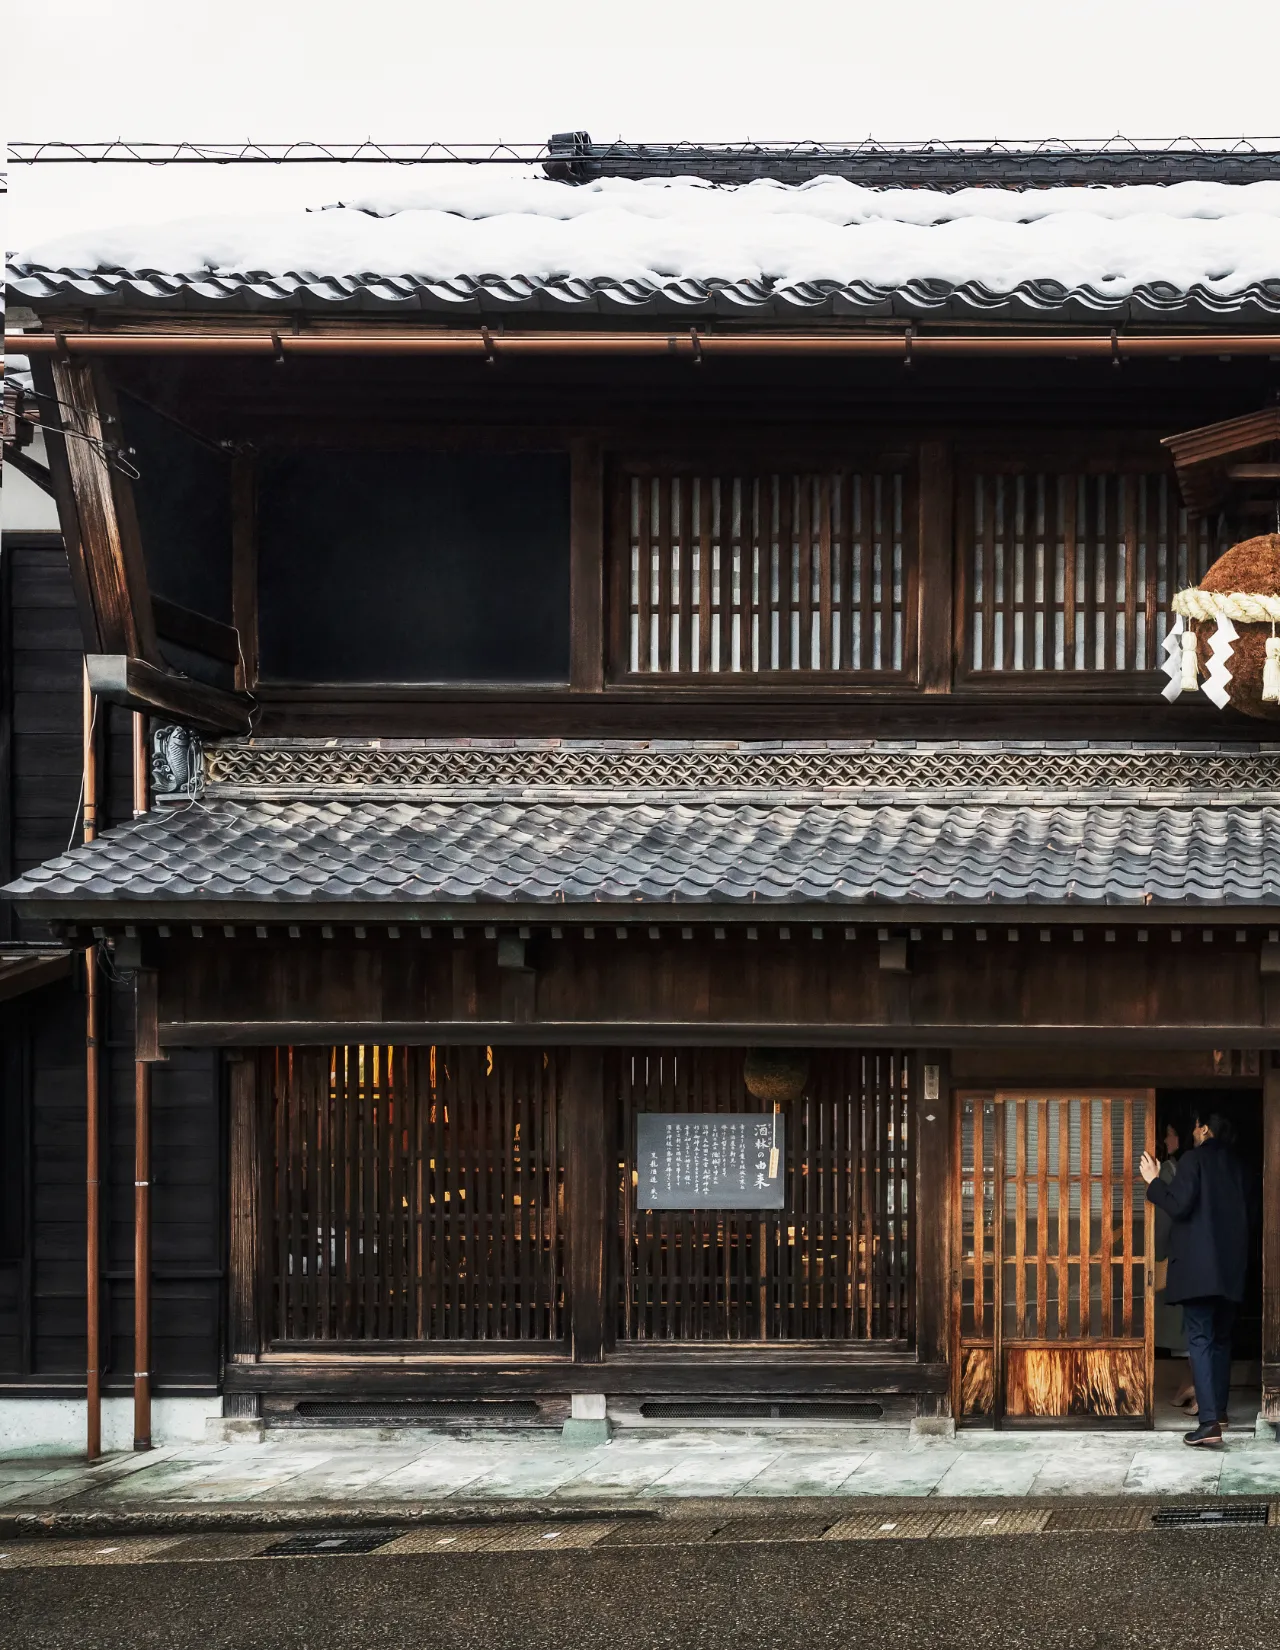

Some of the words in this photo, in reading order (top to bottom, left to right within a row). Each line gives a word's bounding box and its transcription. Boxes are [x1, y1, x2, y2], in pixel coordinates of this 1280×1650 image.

[753, 1123, 770, 1190] 酒林の由来
